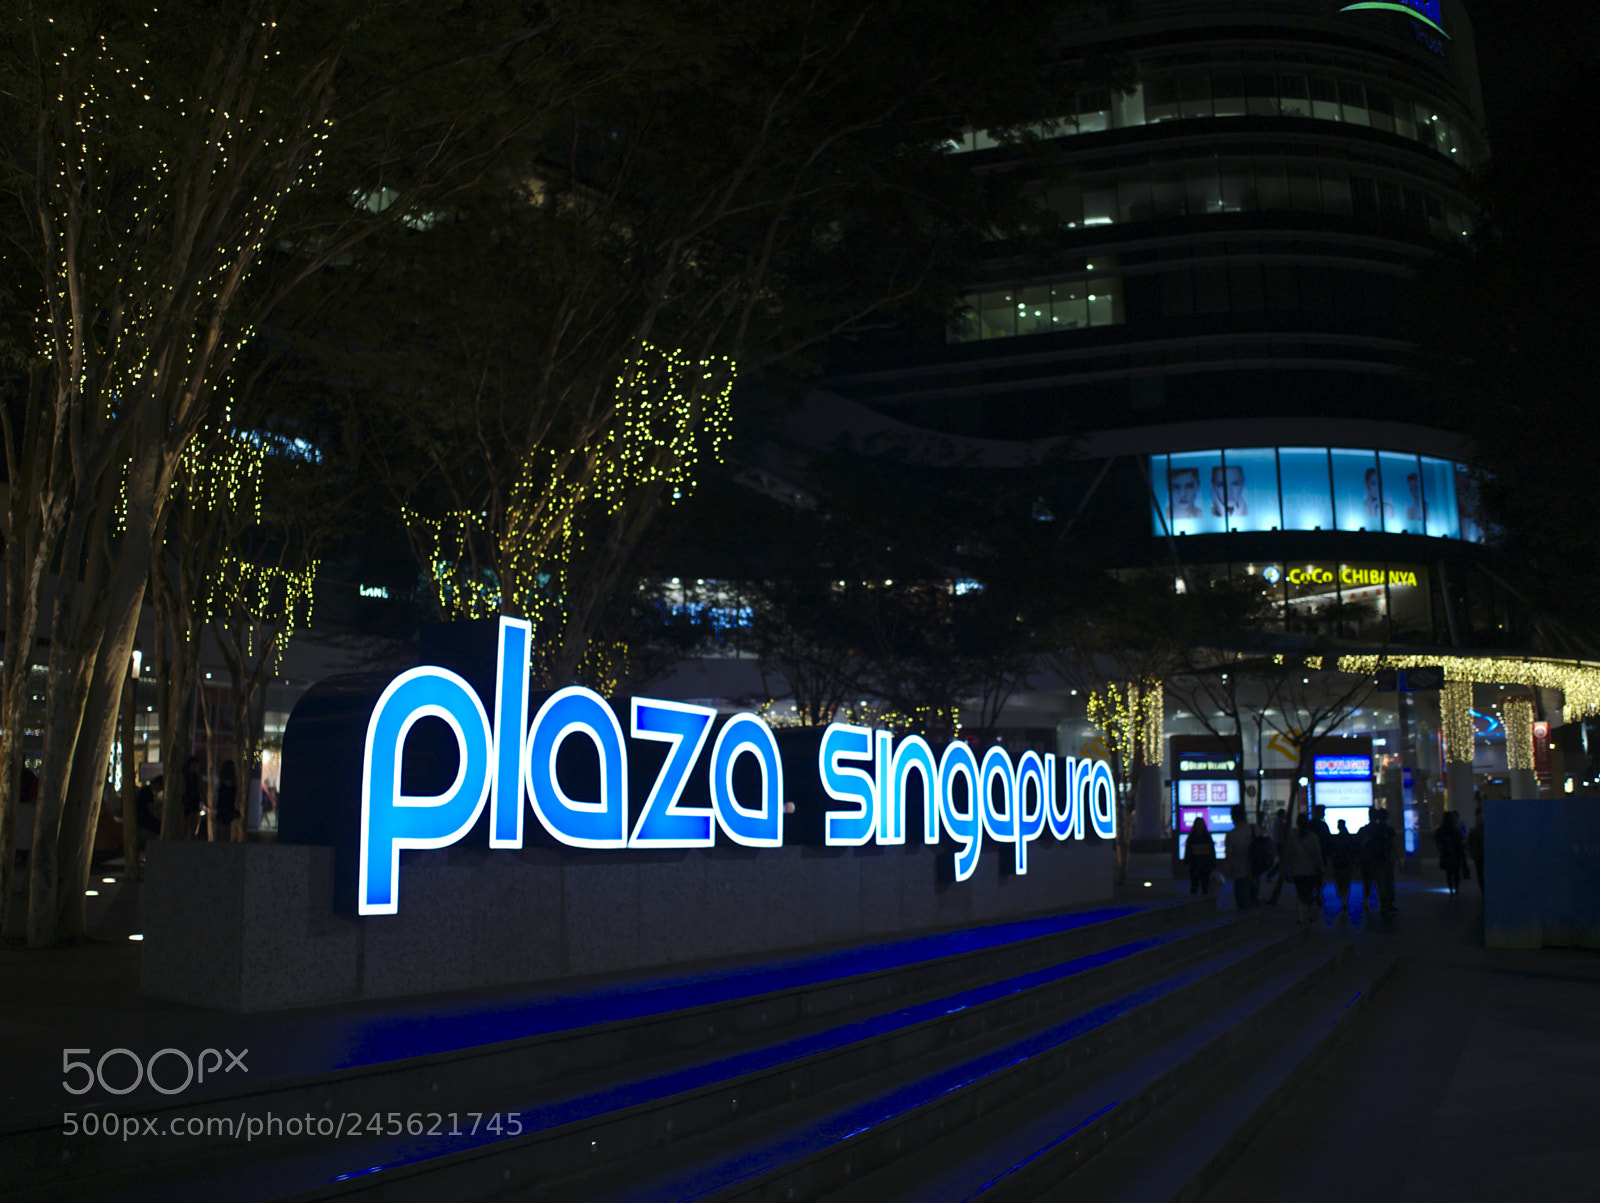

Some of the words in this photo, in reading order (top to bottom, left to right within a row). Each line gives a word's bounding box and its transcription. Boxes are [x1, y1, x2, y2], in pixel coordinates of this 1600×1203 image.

[1289, 567, 1333, 584] CoCo
[358, 615, 784, 916] plaza
[819, 722, 1117, 882] singapura
[1315, 760, 1370, 770] SPOTLIGHT
